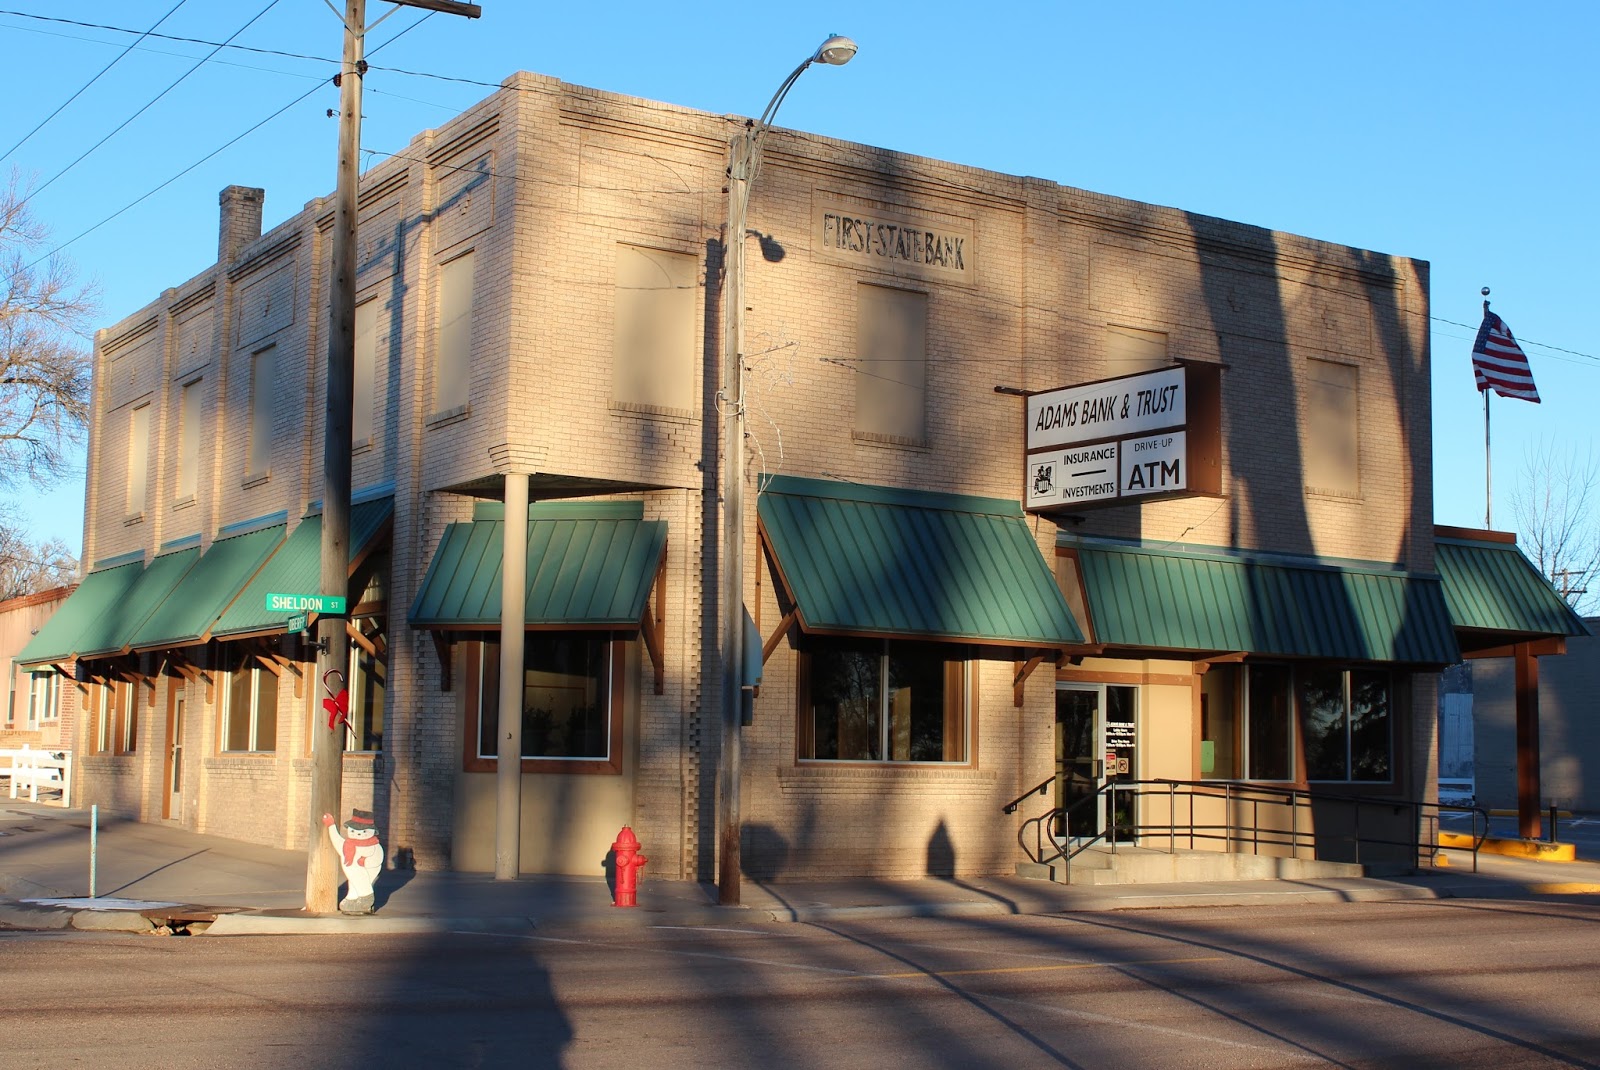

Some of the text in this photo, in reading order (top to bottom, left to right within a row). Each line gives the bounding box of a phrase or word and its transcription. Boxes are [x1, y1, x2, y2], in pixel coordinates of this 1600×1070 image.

[1035, 384, 1179, 431] ADAMS BANK & TRUST
[1063, 447, 1115, 466] INSURANCE
[1127, 458, 1180, 490] ATM
[1062, 482, 1114, 499] INVESTMENTS
[272, 596, 322, 610] SHELDON
